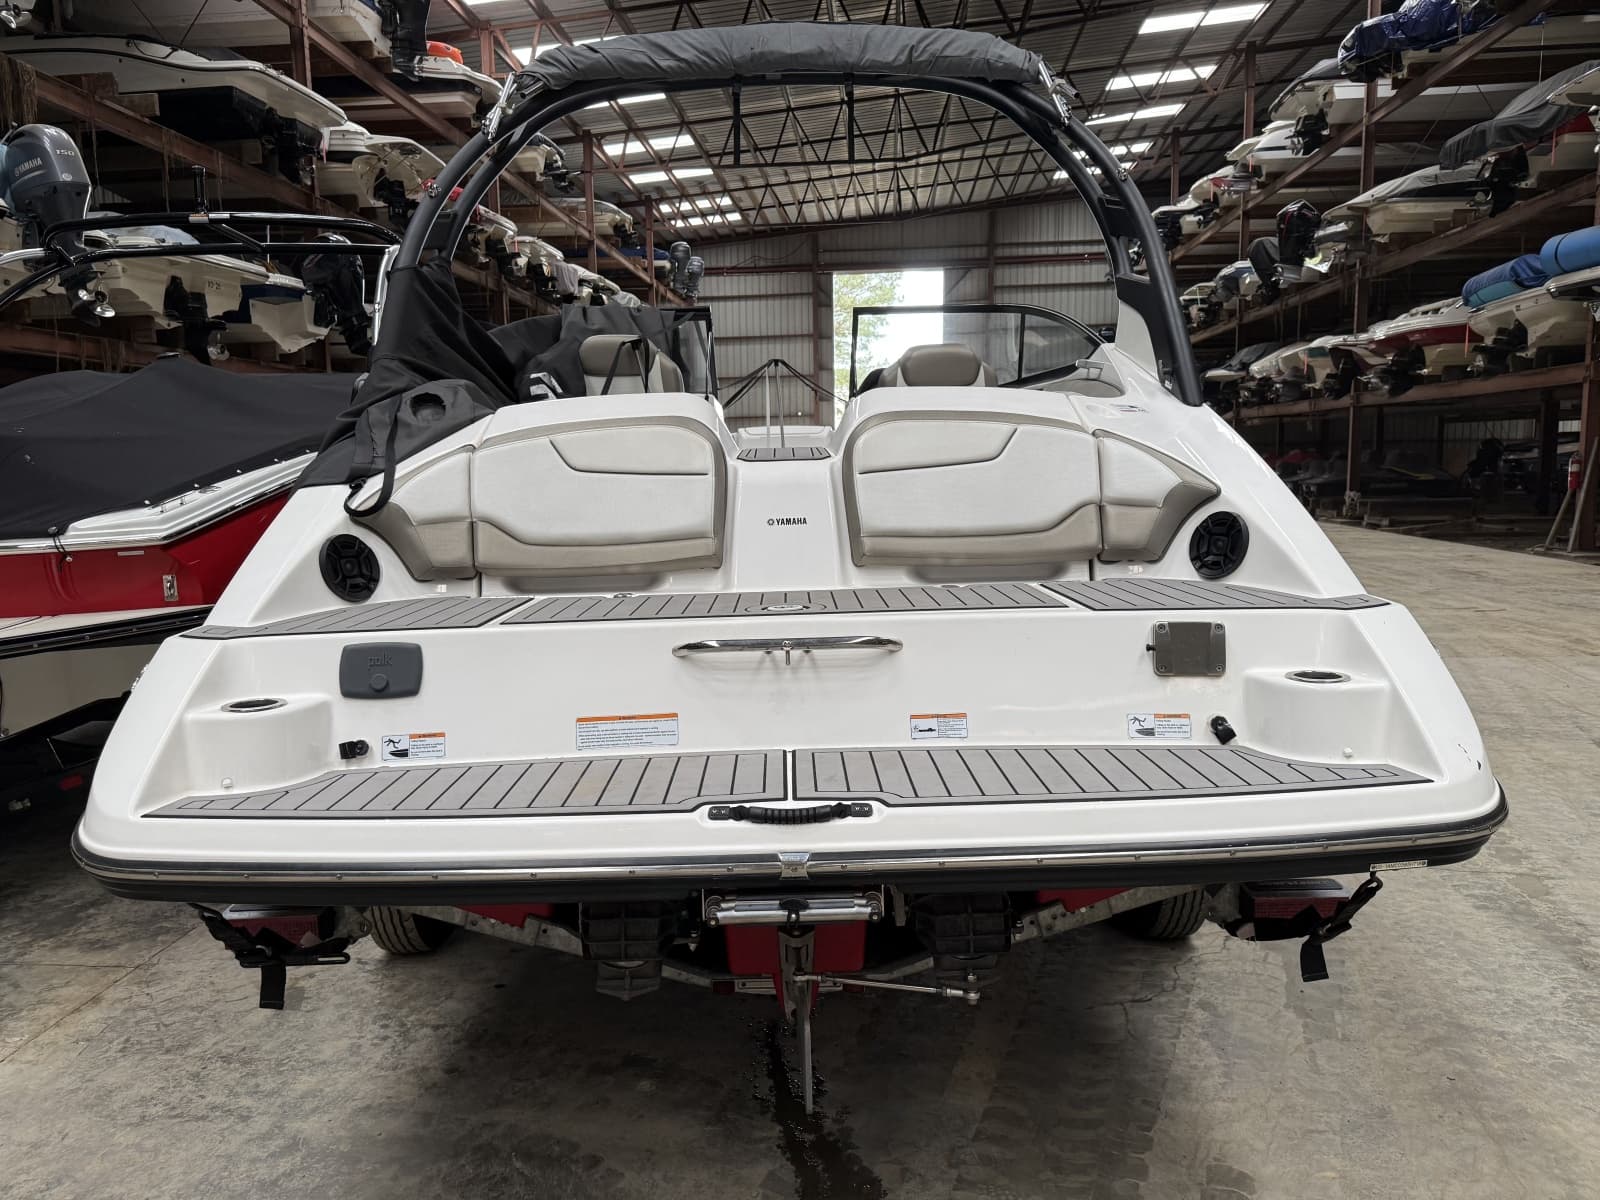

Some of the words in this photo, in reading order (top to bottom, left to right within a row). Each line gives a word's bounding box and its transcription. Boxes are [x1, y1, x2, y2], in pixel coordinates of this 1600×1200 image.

[19, 157, 42, 173] YAMAHA
[775, 517, 807, 526] YAMAHA
[368, 650, 393, 669] polk
